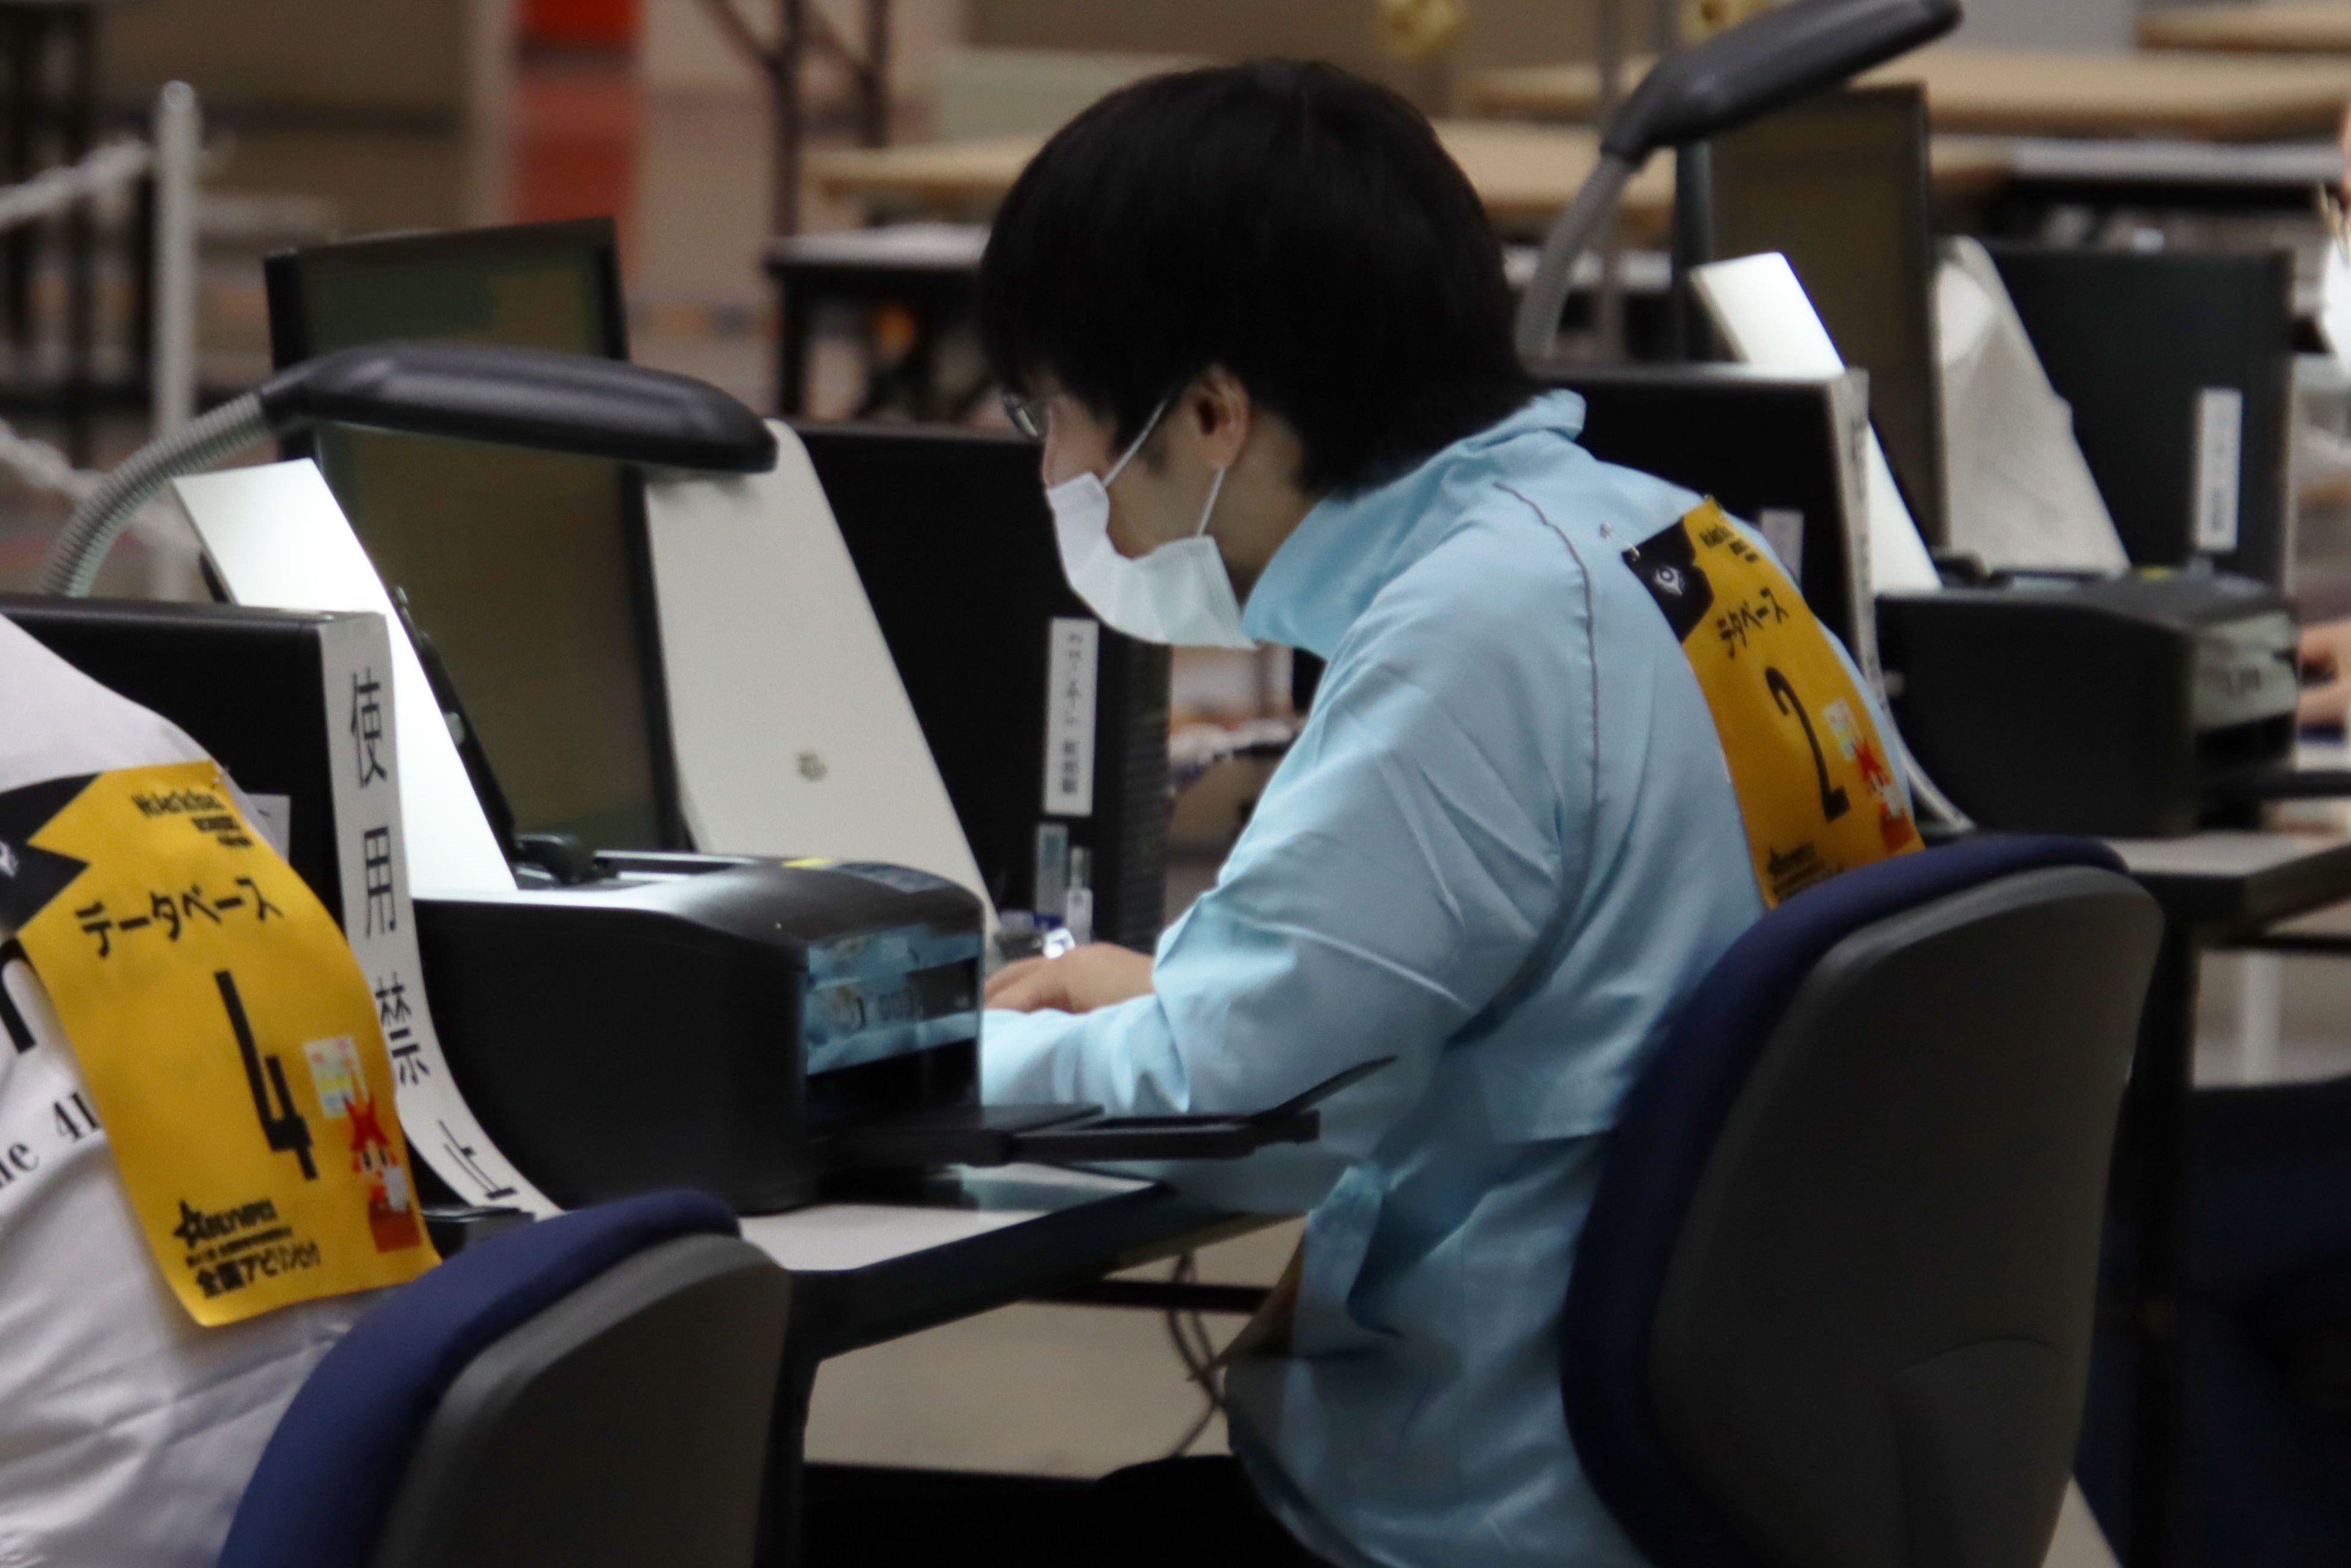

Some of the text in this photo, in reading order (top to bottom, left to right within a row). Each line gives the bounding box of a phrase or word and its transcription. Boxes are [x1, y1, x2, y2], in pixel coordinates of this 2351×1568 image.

[1717, 586, 1790, 660] データベース
[1764, 666, 1851, 824] 2
[75, 877, 284, 959] データベース
[350, 666, 518, 1200] 使用禁止
[213, 969, 319, 1181] 4
